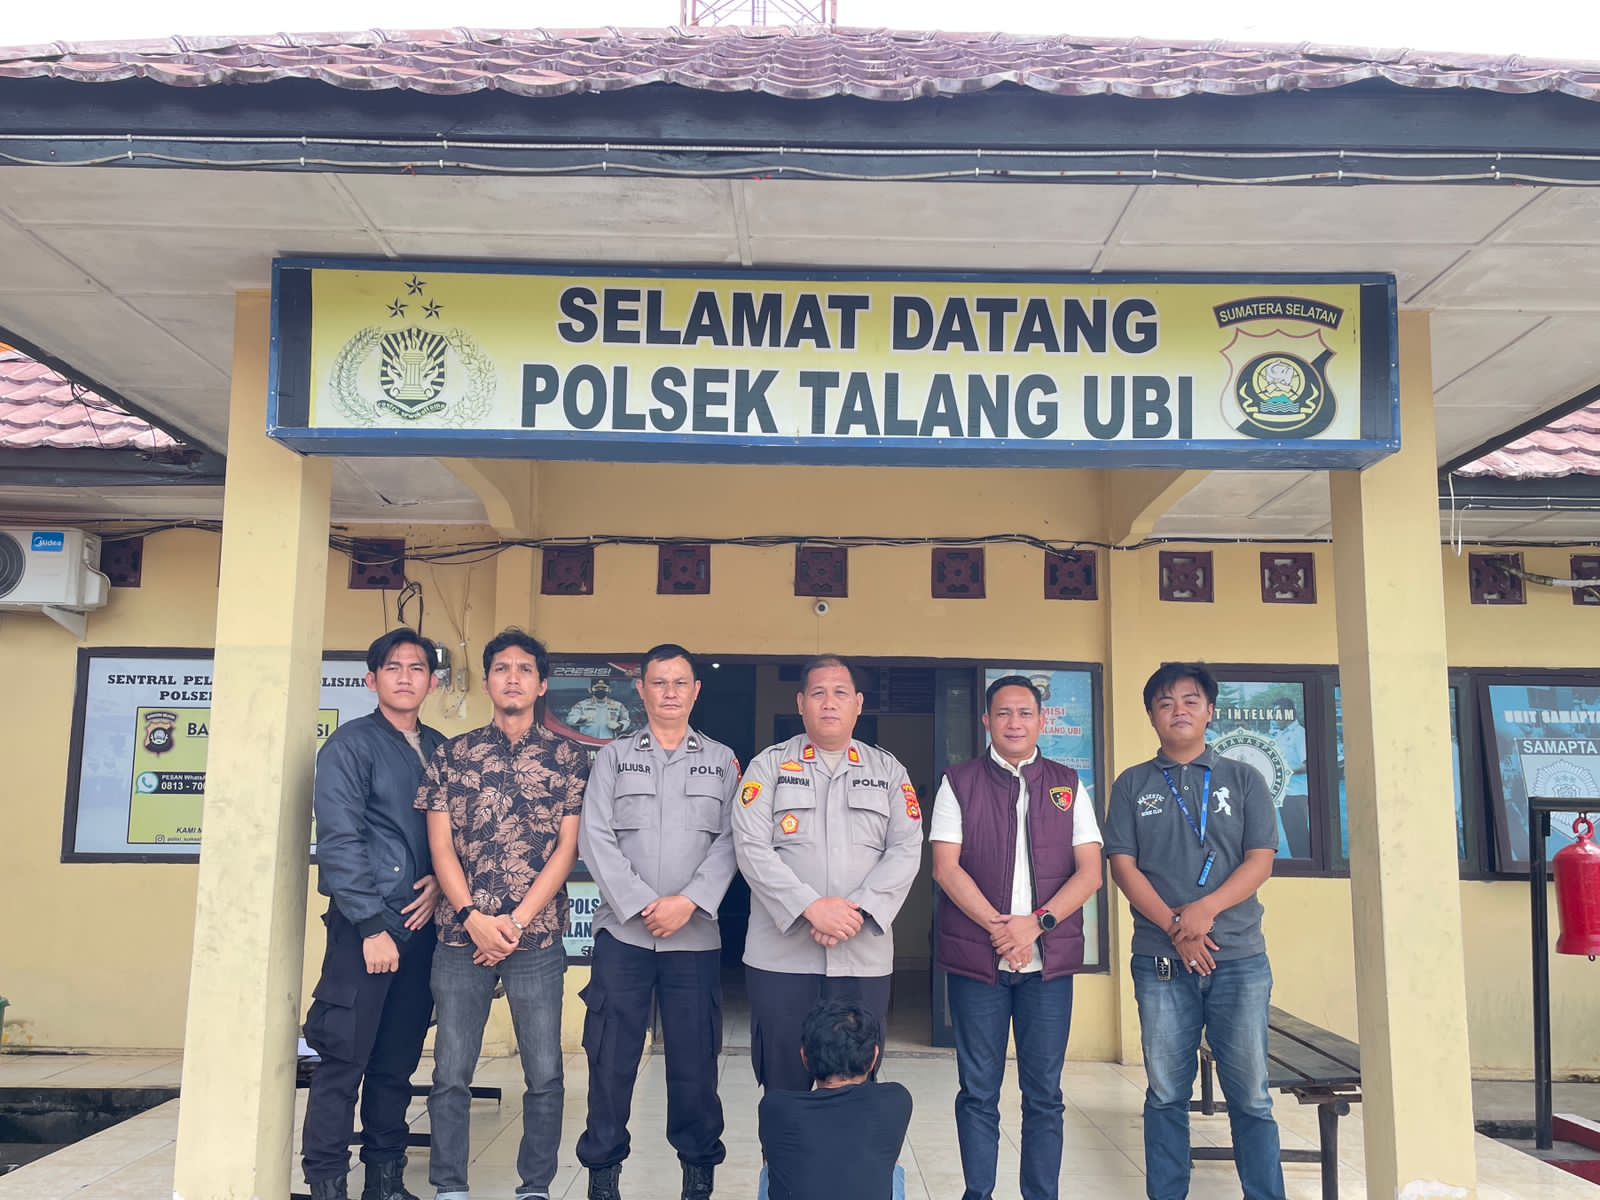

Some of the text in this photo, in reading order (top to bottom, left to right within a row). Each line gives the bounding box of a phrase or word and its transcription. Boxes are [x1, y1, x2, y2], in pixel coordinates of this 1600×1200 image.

[557, 286, 1158, 354] SELAMAT DATANG
[1219, 302, 1338, 325] SUMATERA SELATAN
[521, 363, 1193, 440] POLSEK TALANG UBI
[33, 536, 62, 547] Midea
[107, 674, 368, 688] SENTRAL PEL LISIAN
[160, 690, 212, 701] POLSE
[1227, 708, 1294, 721] INTELKAM
[187, 722, 329, 737] BA SI
[1523, 740, 1598, 754] SAMAPTA
[161, 781, 184, 790] 0813
[852, 778, 889, 790] POLRI
[569, 898, 600, 915] POLS
